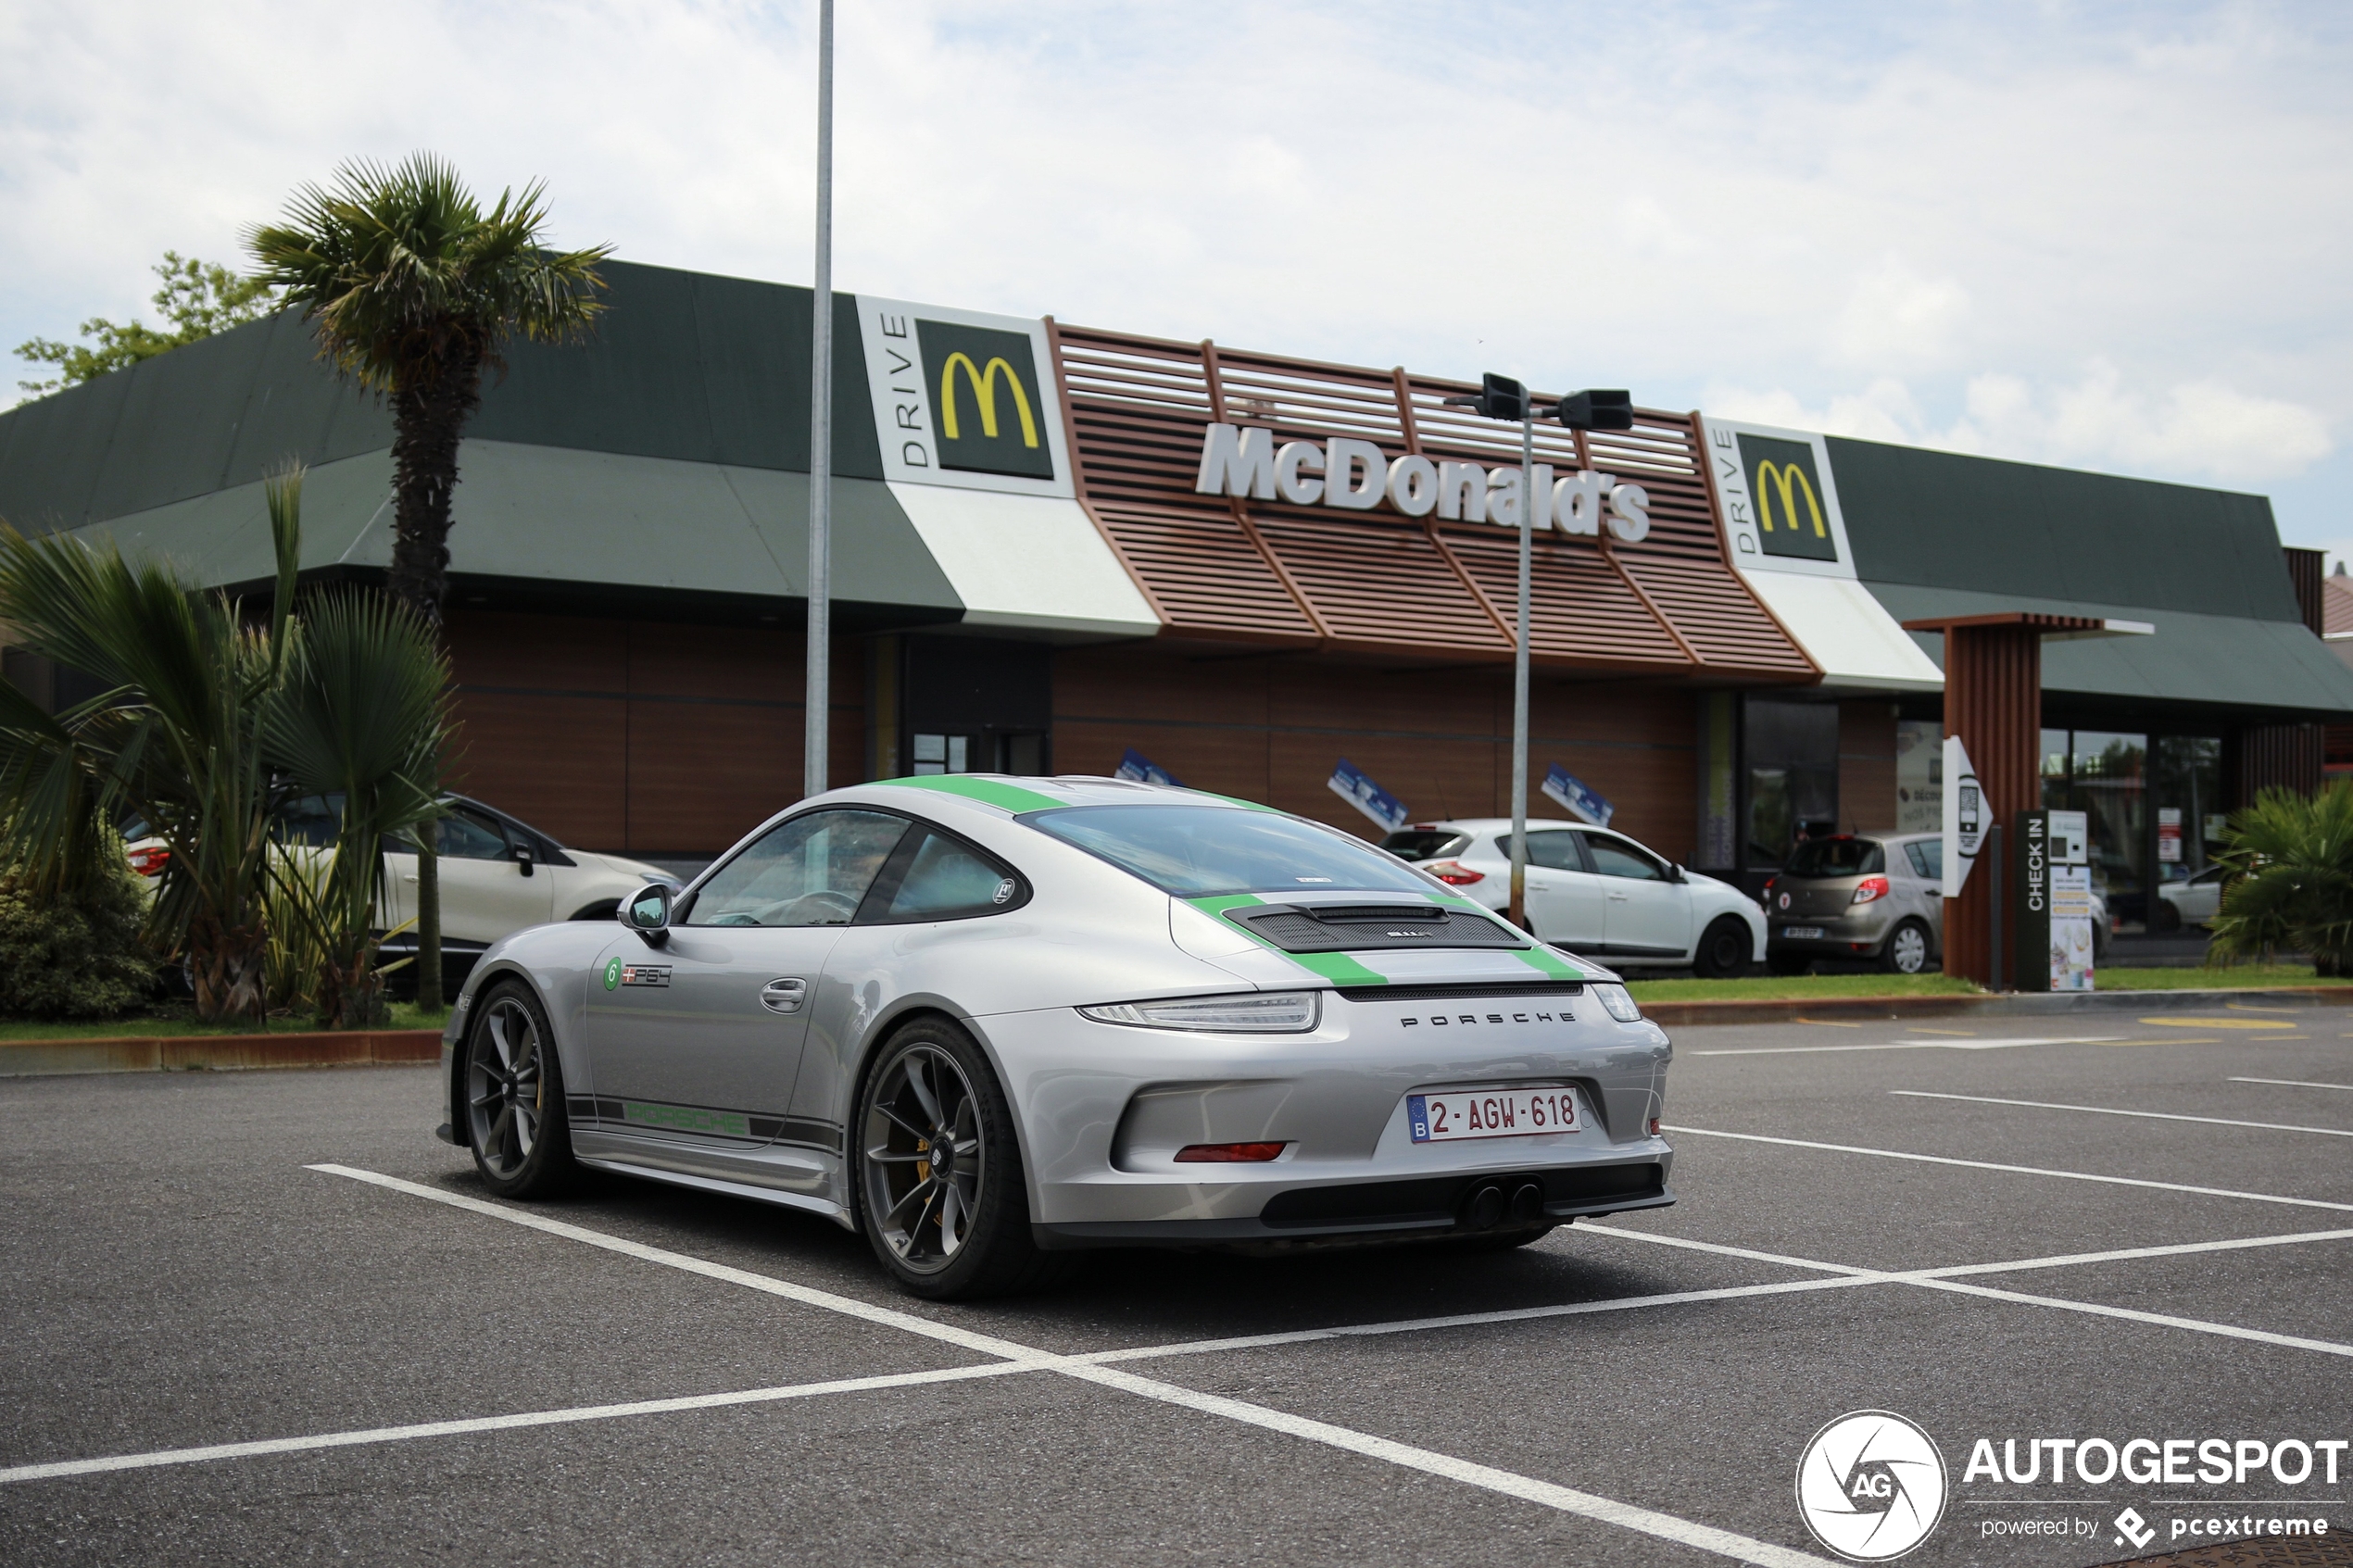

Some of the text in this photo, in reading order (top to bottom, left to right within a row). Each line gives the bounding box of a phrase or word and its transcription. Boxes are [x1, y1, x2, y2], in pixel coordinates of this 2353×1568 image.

[880, 313, 928, 468] DRIVE
[1195, 422, 1651, 542] McDonald's
[1713, 428, 1755, 554] DRIVE
[2028, 819, 2044, 911] CHECK IN
[608, 963, 618, 982] 6
[1401, 1012, 1577, 1028] PORSCHE
[627, 1102, 745, 1135] PORSCHE
[1415, 1123, 1427, 1137] B
[1430, 1094, 1576, 1133] 2-AGW-618
